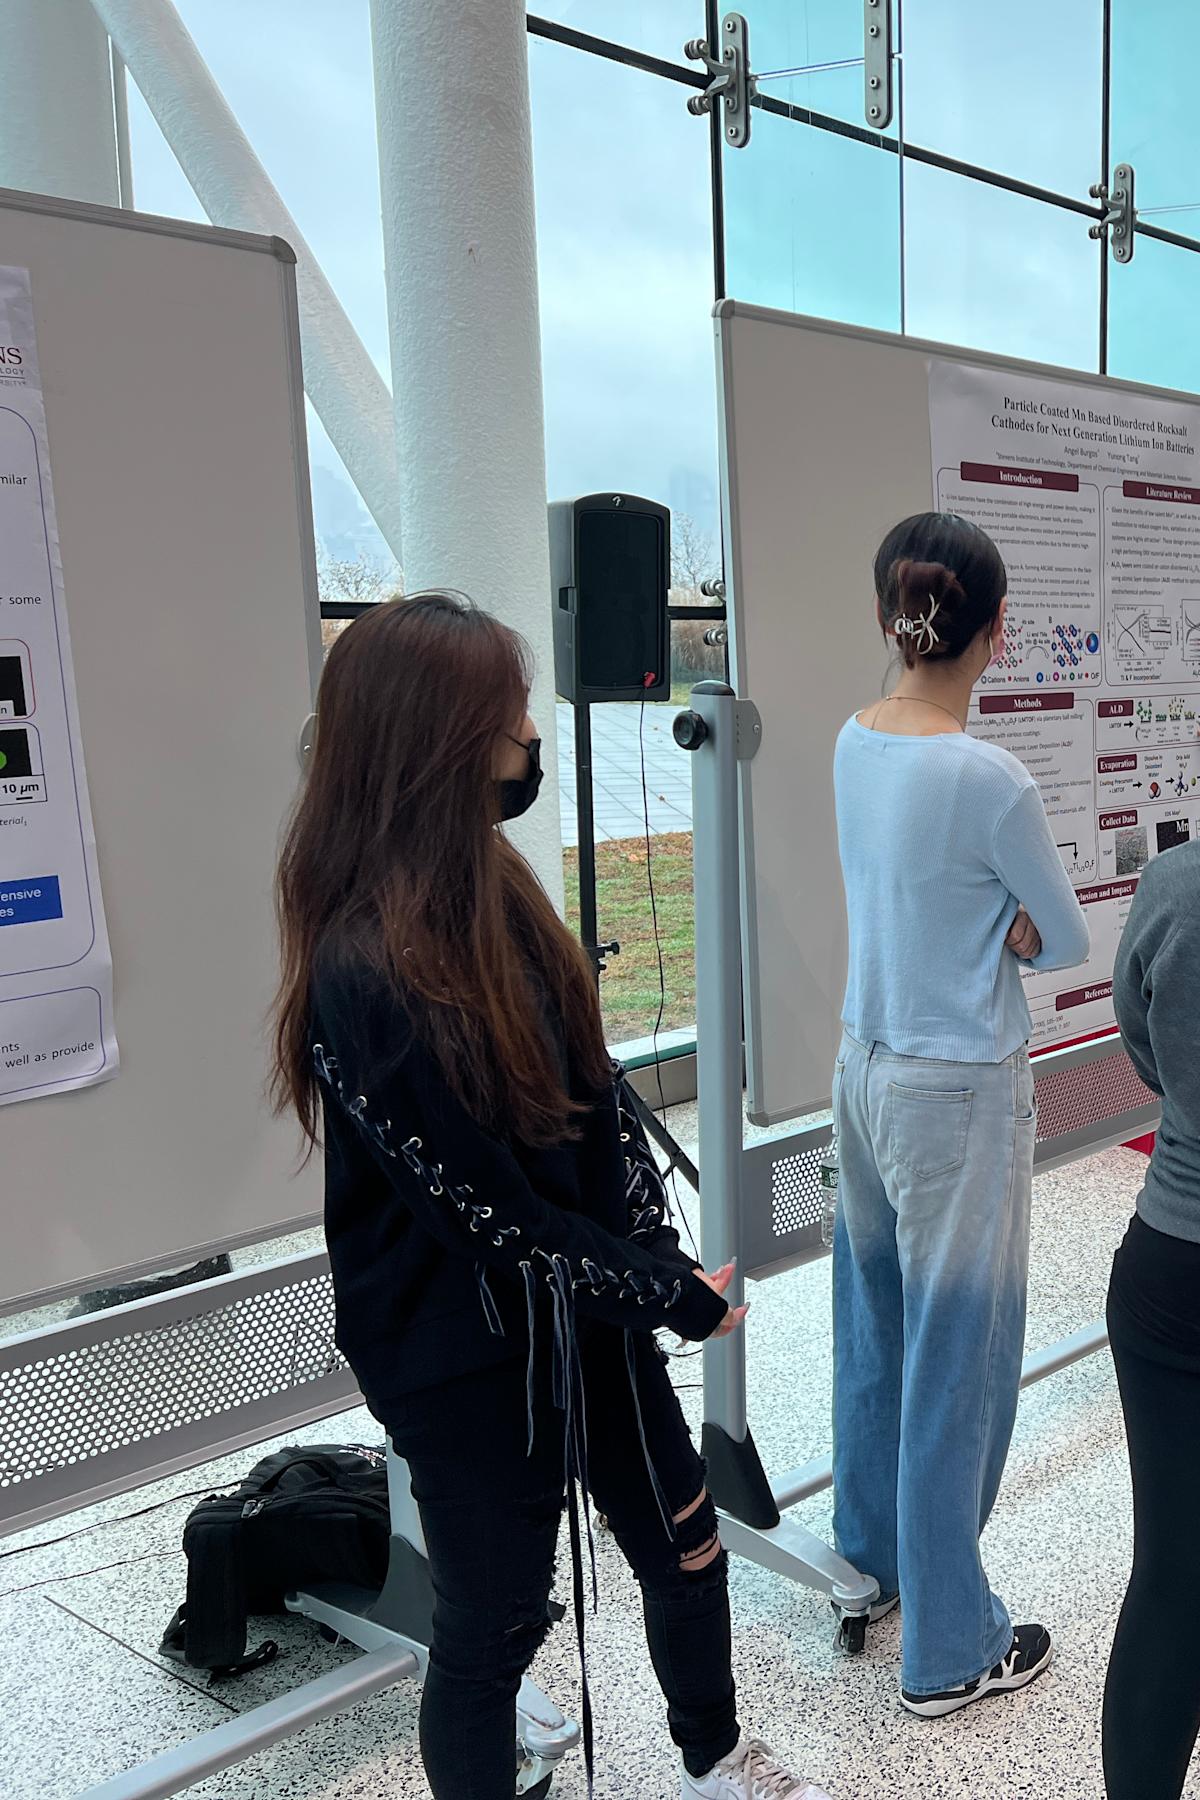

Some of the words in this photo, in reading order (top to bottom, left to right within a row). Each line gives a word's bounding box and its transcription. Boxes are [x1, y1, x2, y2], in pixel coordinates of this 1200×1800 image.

[1004, 396, 1038, 414] Particle
[1040, 402, 1069, 418] Coated
[1072, 408, 1086, 422] Mn
[1088, 411, 1111, 425] Based
[1113, 416, 1155, 432] Disordered
[1157, 422, 1188, 437] Rocksalt
[991, 415, 1034, 433] Cathodes
[1037, 422, 1049, 434] for
[1052, 424, 1071, 438] Next
[1074, 428, 1117, 444] Generation
[1119, 434, 1150, 448] Lithium
[1152, 438, 1164, 450] Ion
[1166, 440, 1194, 455] Batteries
[1000, 472, 1042, 485] Introduction
[1146, 486, 1173, 498] Literature
[1174, 490, 1192, 500] Review
[1014, 698, 1042, 709] Methods
[1109, 705, 1123, 714] ALD
[1100, 759, 1136, 771] Evaporation
[3, 784, 16, 794] 10
[1101, 816, 1121, 827] Collect
[1122, 815, 1136, 824] Data
[1176, 820, 1188, 832] Mn
[1099, 888, 1110, 897] and
[1112, 885, 1132, 896] Impact
[5, 1054, 29, 1068] well
[35, 1053, 46, 1062] as
[52, 1042, 94, 1060] provide
